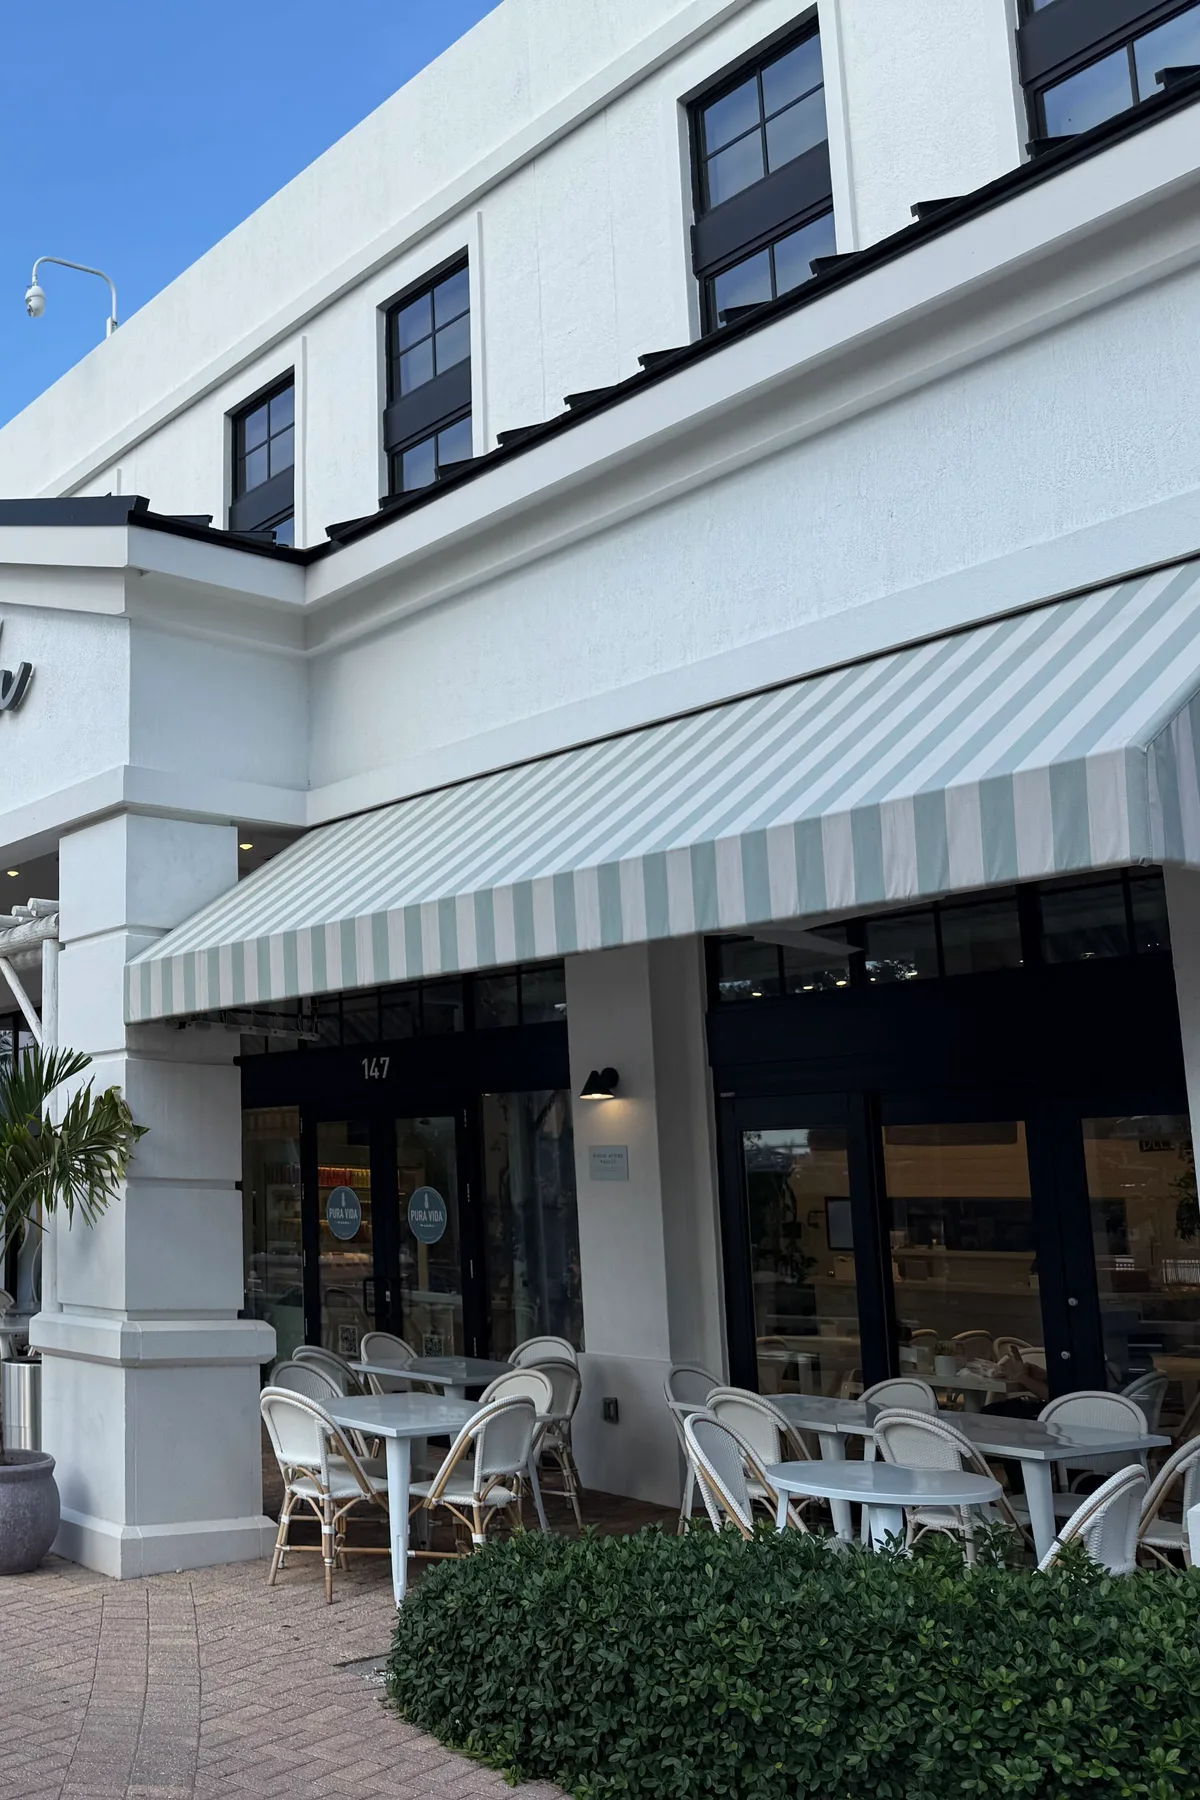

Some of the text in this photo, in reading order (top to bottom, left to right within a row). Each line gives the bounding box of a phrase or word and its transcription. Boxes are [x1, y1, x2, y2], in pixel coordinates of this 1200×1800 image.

[362, 1057, 390, 1079] 147
[329, 1208, 358, 1219] PURA VIDA
[411, 1210, 443, 1222] PURA VIDA
